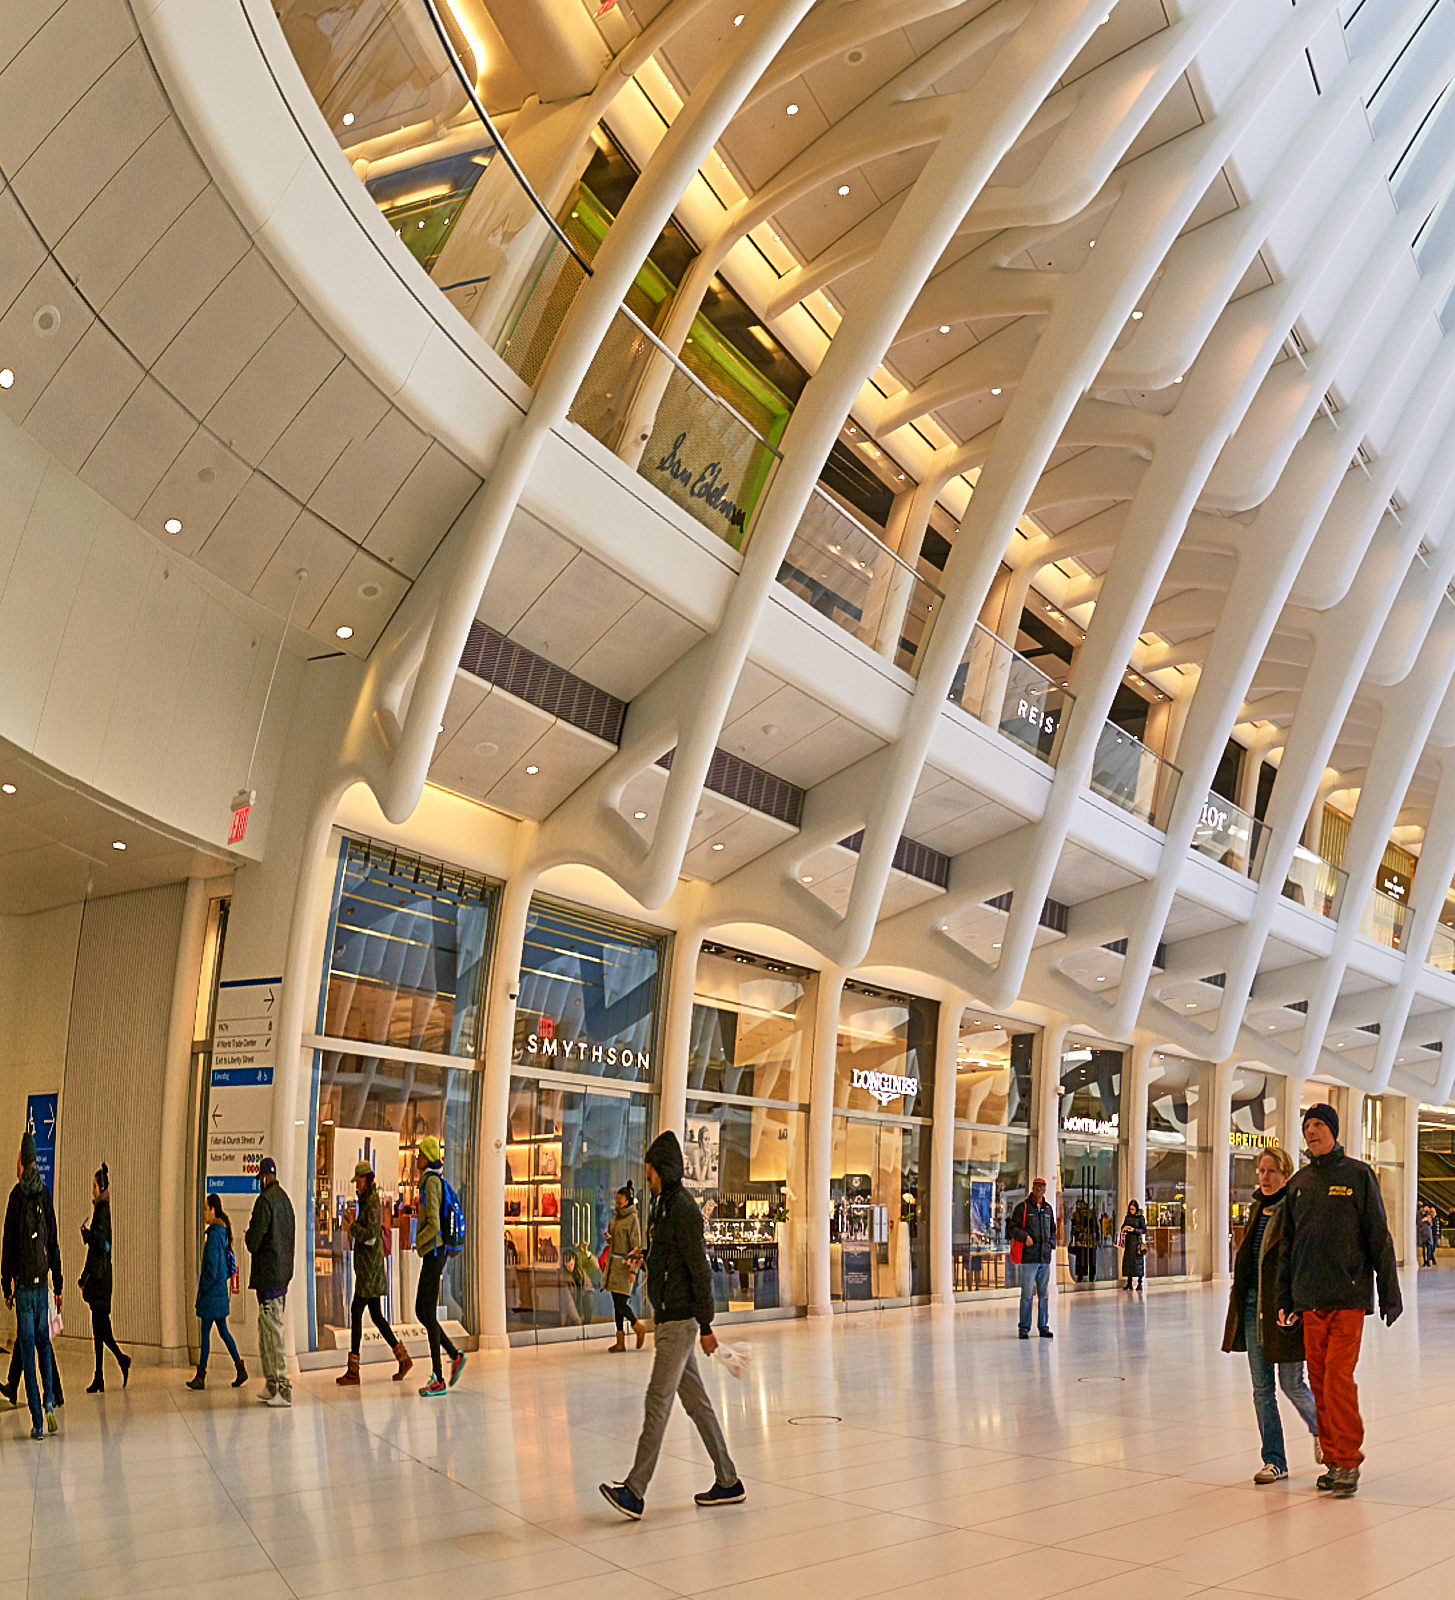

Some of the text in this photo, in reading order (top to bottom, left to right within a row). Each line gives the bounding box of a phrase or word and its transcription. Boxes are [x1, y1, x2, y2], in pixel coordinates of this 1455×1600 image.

[656, 432, 747, 534] Sam Edelman
[1018, 699, 1061, 734] REIS
[230, 806, 249, 843] EXIT
[1201, 795, 1228, 831] ior
[527, 1033, 650, 1070] SMYTHSON
[852, 1068, 918, 1096] LONGINES
[1229, 1132, 1280, 1148] BREITLING
[363, 1327, 428, 1341] SMTHSO
